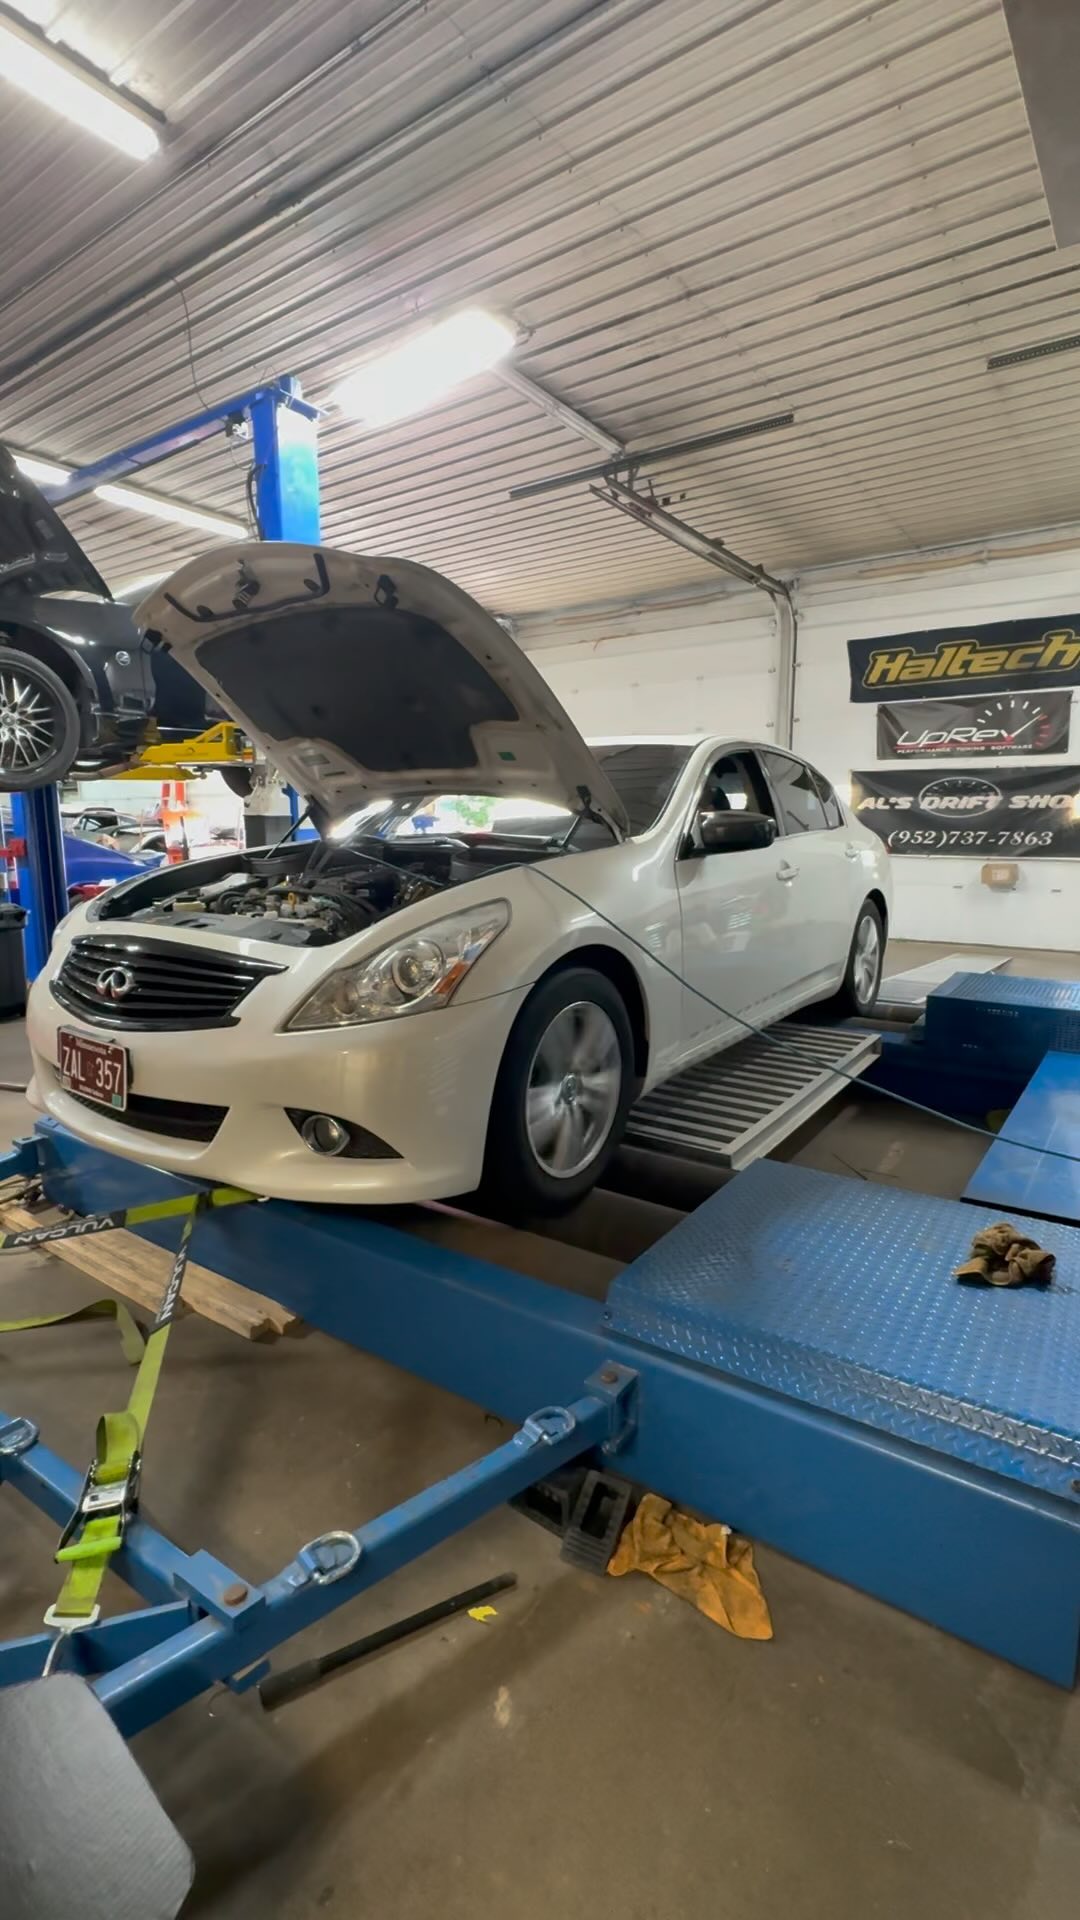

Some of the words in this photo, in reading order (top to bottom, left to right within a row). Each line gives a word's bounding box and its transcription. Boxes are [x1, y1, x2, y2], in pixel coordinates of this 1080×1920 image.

[864, 632, 1080, 687] Haltech
[897, 722, 1022, 747] UpRev
[857, 797, 914, 810] AL'S
[919, 794, 1002, 810] DRIFT
[1008, 794, 1080, 809] SHO
[887, 830, 1054, 848] (952)737-7863
[63, 1046, 86, 1082] ZAL
[96, 1057, 121, 1094] 357
[13, 1218, 115, 1245] VULCAN
